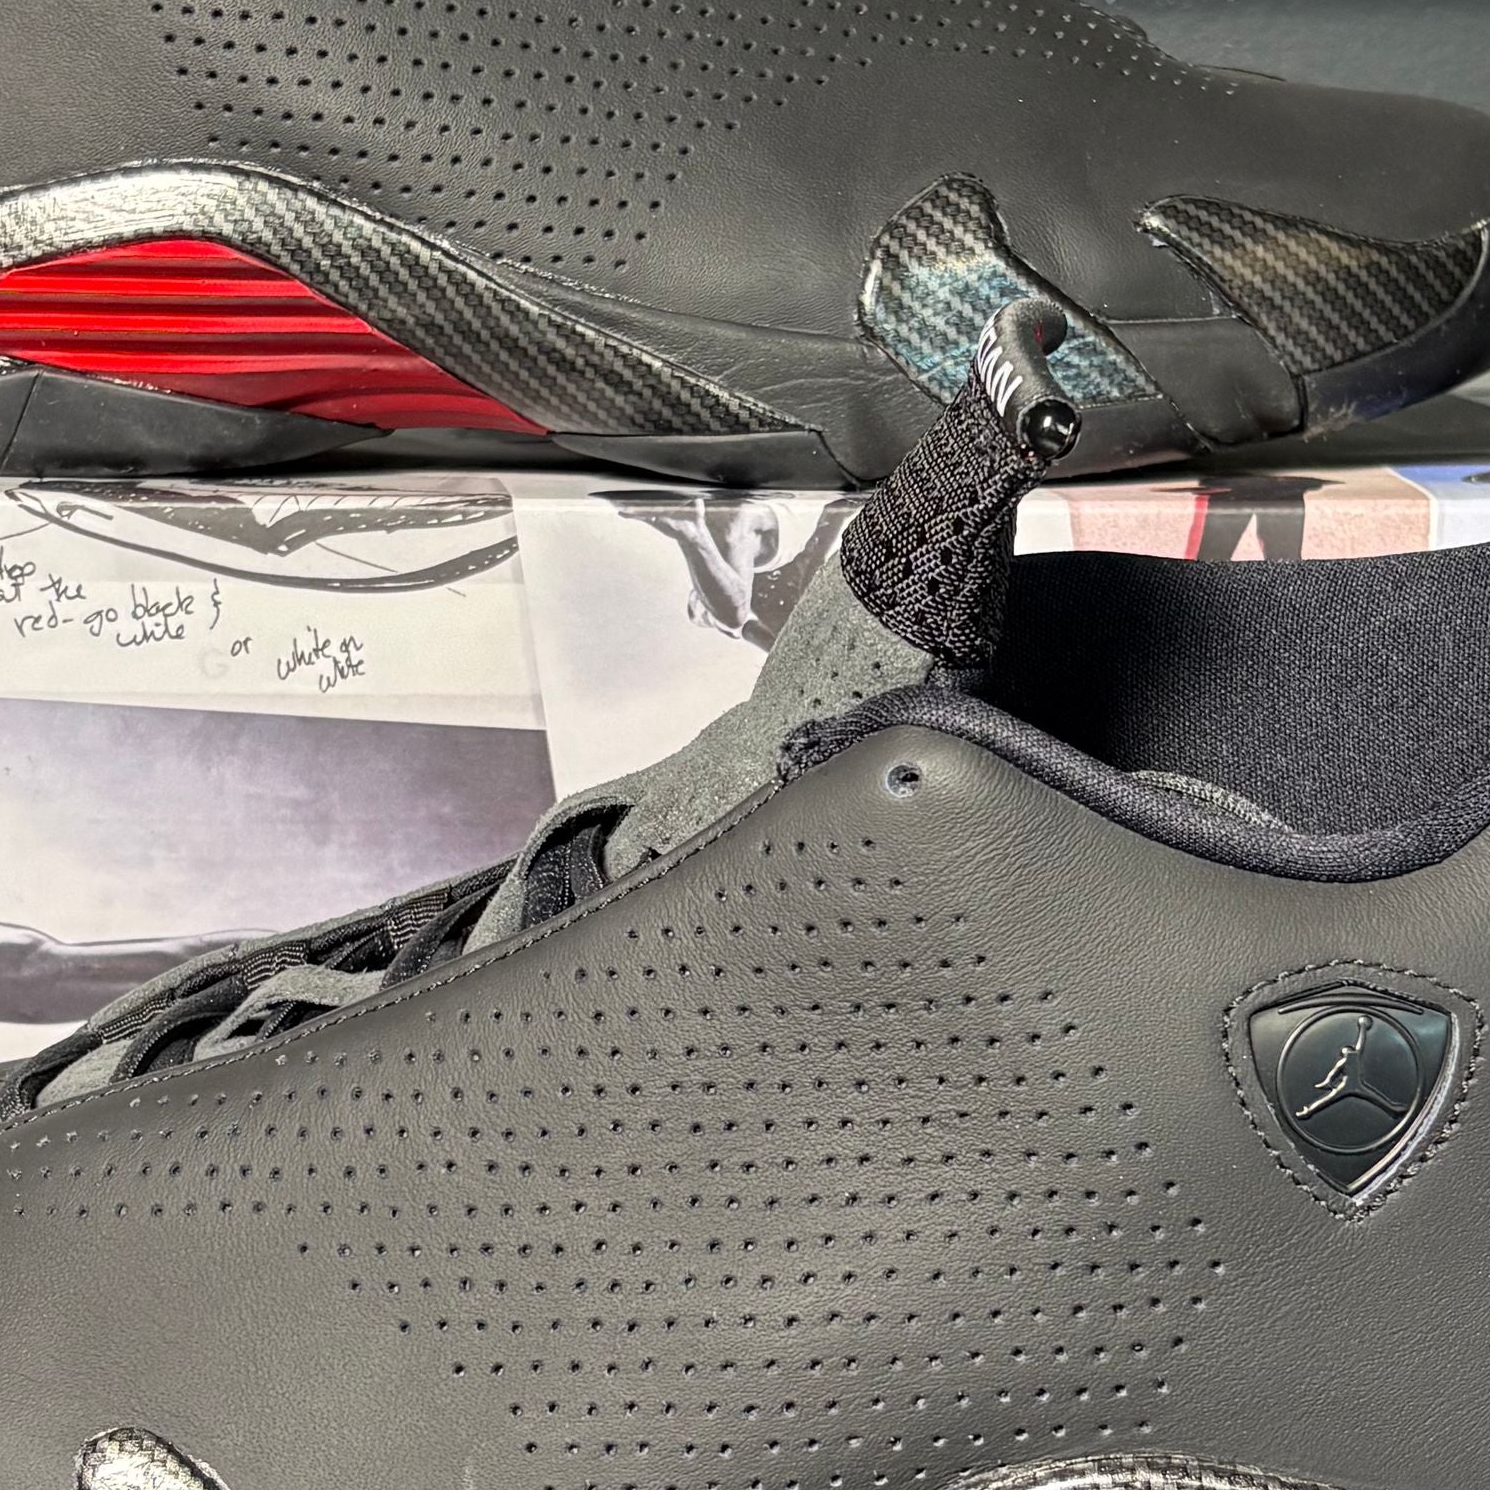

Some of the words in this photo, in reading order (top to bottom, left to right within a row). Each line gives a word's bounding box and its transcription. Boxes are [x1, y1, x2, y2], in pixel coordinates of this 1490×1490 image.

[84, 608, 118, 637] go
[131, 584, 194, 620] black
[231, 637, 252, 656] or
[277, 626, 331, 680] white
